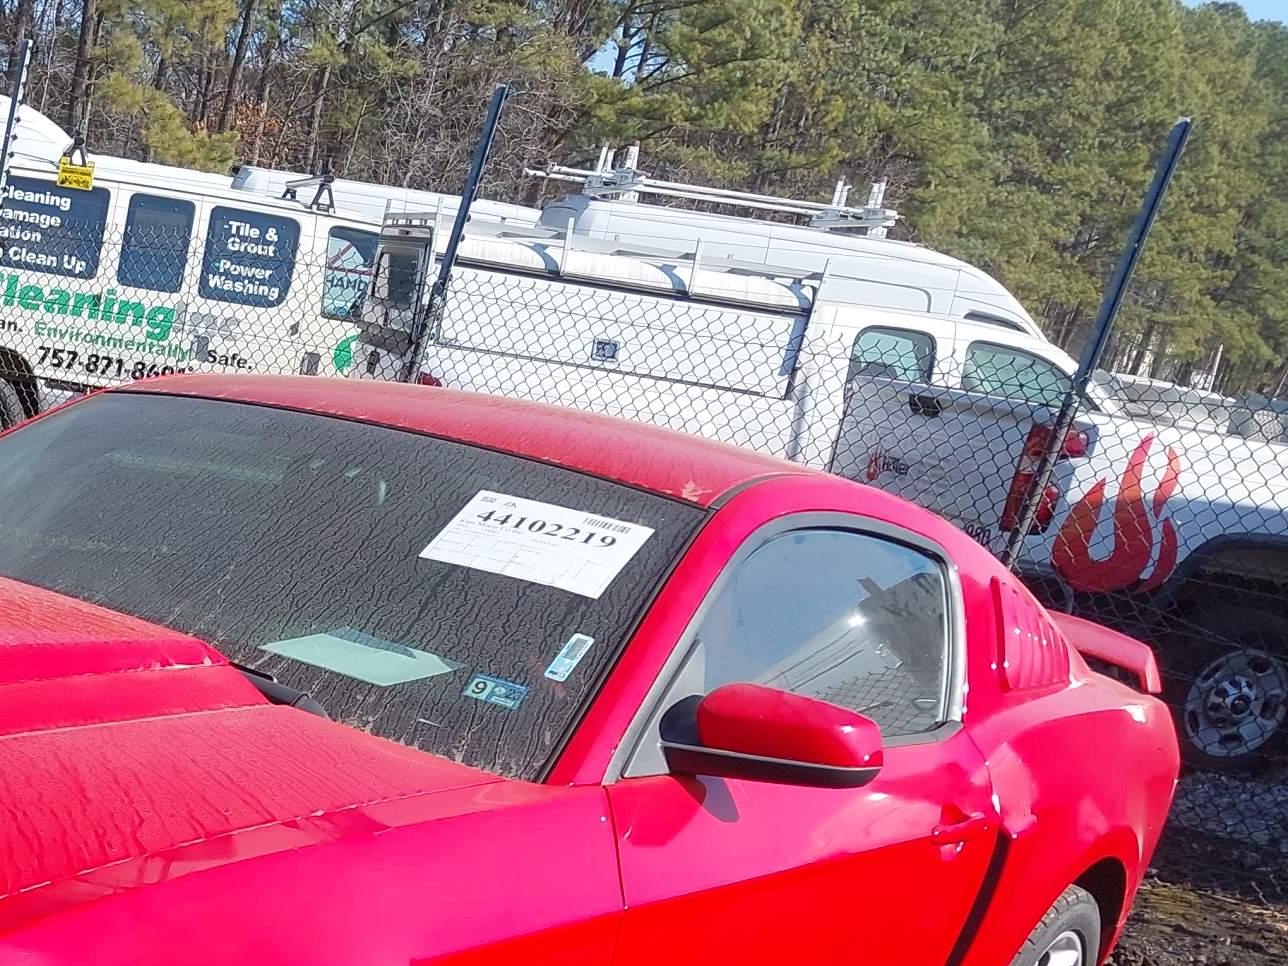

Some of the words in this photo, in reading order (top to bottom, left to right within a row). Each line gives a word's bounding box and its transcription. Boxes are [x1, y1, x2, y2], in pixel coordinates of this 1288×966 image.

[227, 237, 275, 257] Grout
[265, 227, 279, 242] &
[9, 246, 57, 267] Clean
[63, 254, 87, 274] Up
[208, 273, 279, 301] Washing
[35, 320, 190, 362] Environmentally
[206, 349, 253, 370] Safe.
[477, 509, 617, 548] 44102219
[471, 680, 488, 695] 9
